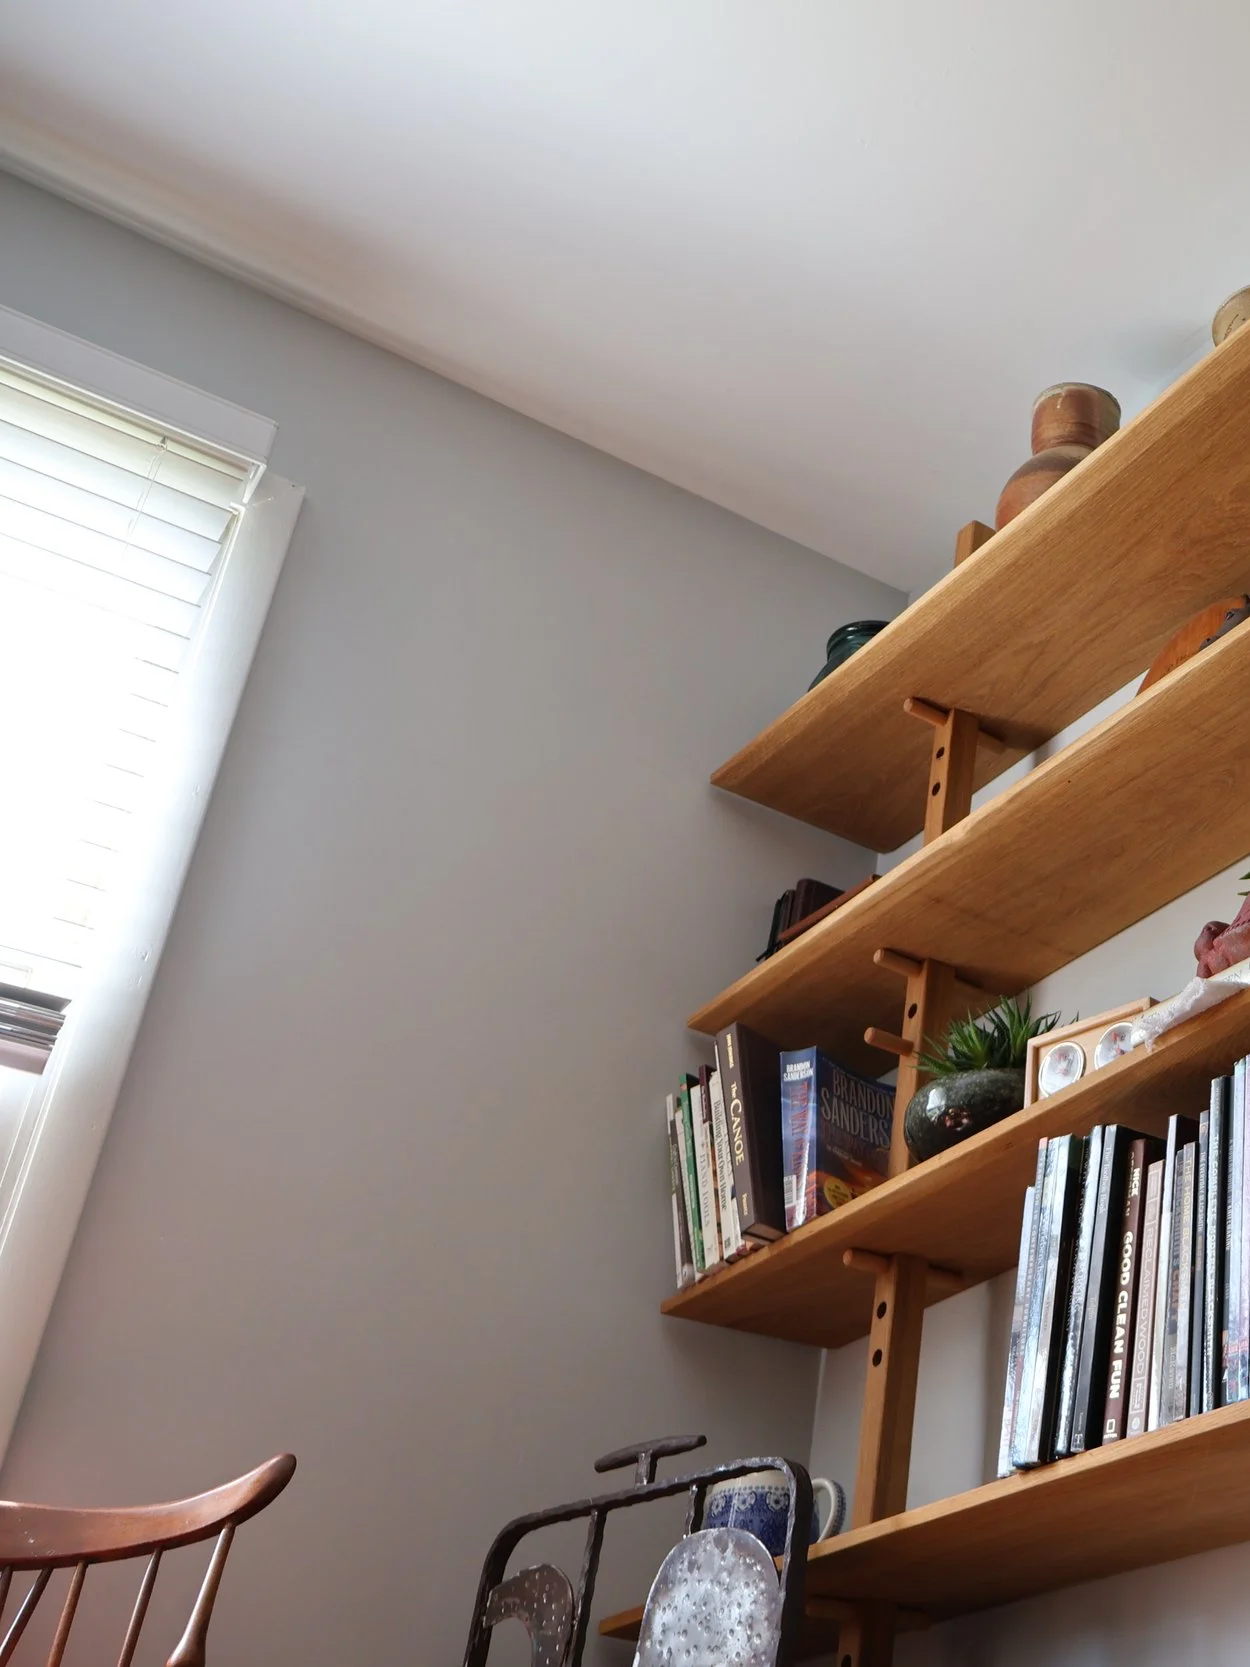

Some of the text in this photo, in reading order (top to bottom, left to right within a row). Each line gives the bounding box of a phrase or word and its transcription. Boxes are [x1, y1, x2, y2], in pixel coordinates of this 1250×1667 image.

[783, 1067, 814, 1082] SANDERSON
[786, 1060, 811, 1073] BRANDON
[730, 1081, 738, 1098] The
[713, 1100, 722, 1139] Building
[731, 1098, 745, 1166] CANOE
[716, 1138, 724, 1160] Your
[718, 1160, 726, 1181] Own
[1098, 1145, 1111, 1214] The Toolbox Book
[1131, 1167, 1140, 1196] NICK
[719, 1181, 728, 1211] Home
[1178, 1160, 1192, 1308] THE HOME BLACKSMITH
[1026, 1224, 1037, 1298] CONTEMPORARY
[1119, 1230, 1134, 1286] GOOD
[1139, 1226, 1153, 1319] RECLAIMED
[1112, 1290, 1129, 1354] CLEAN
[1135, 1322, 1146, 1374] WOOD
[1108, 1358, 1122, 1400] FUN
